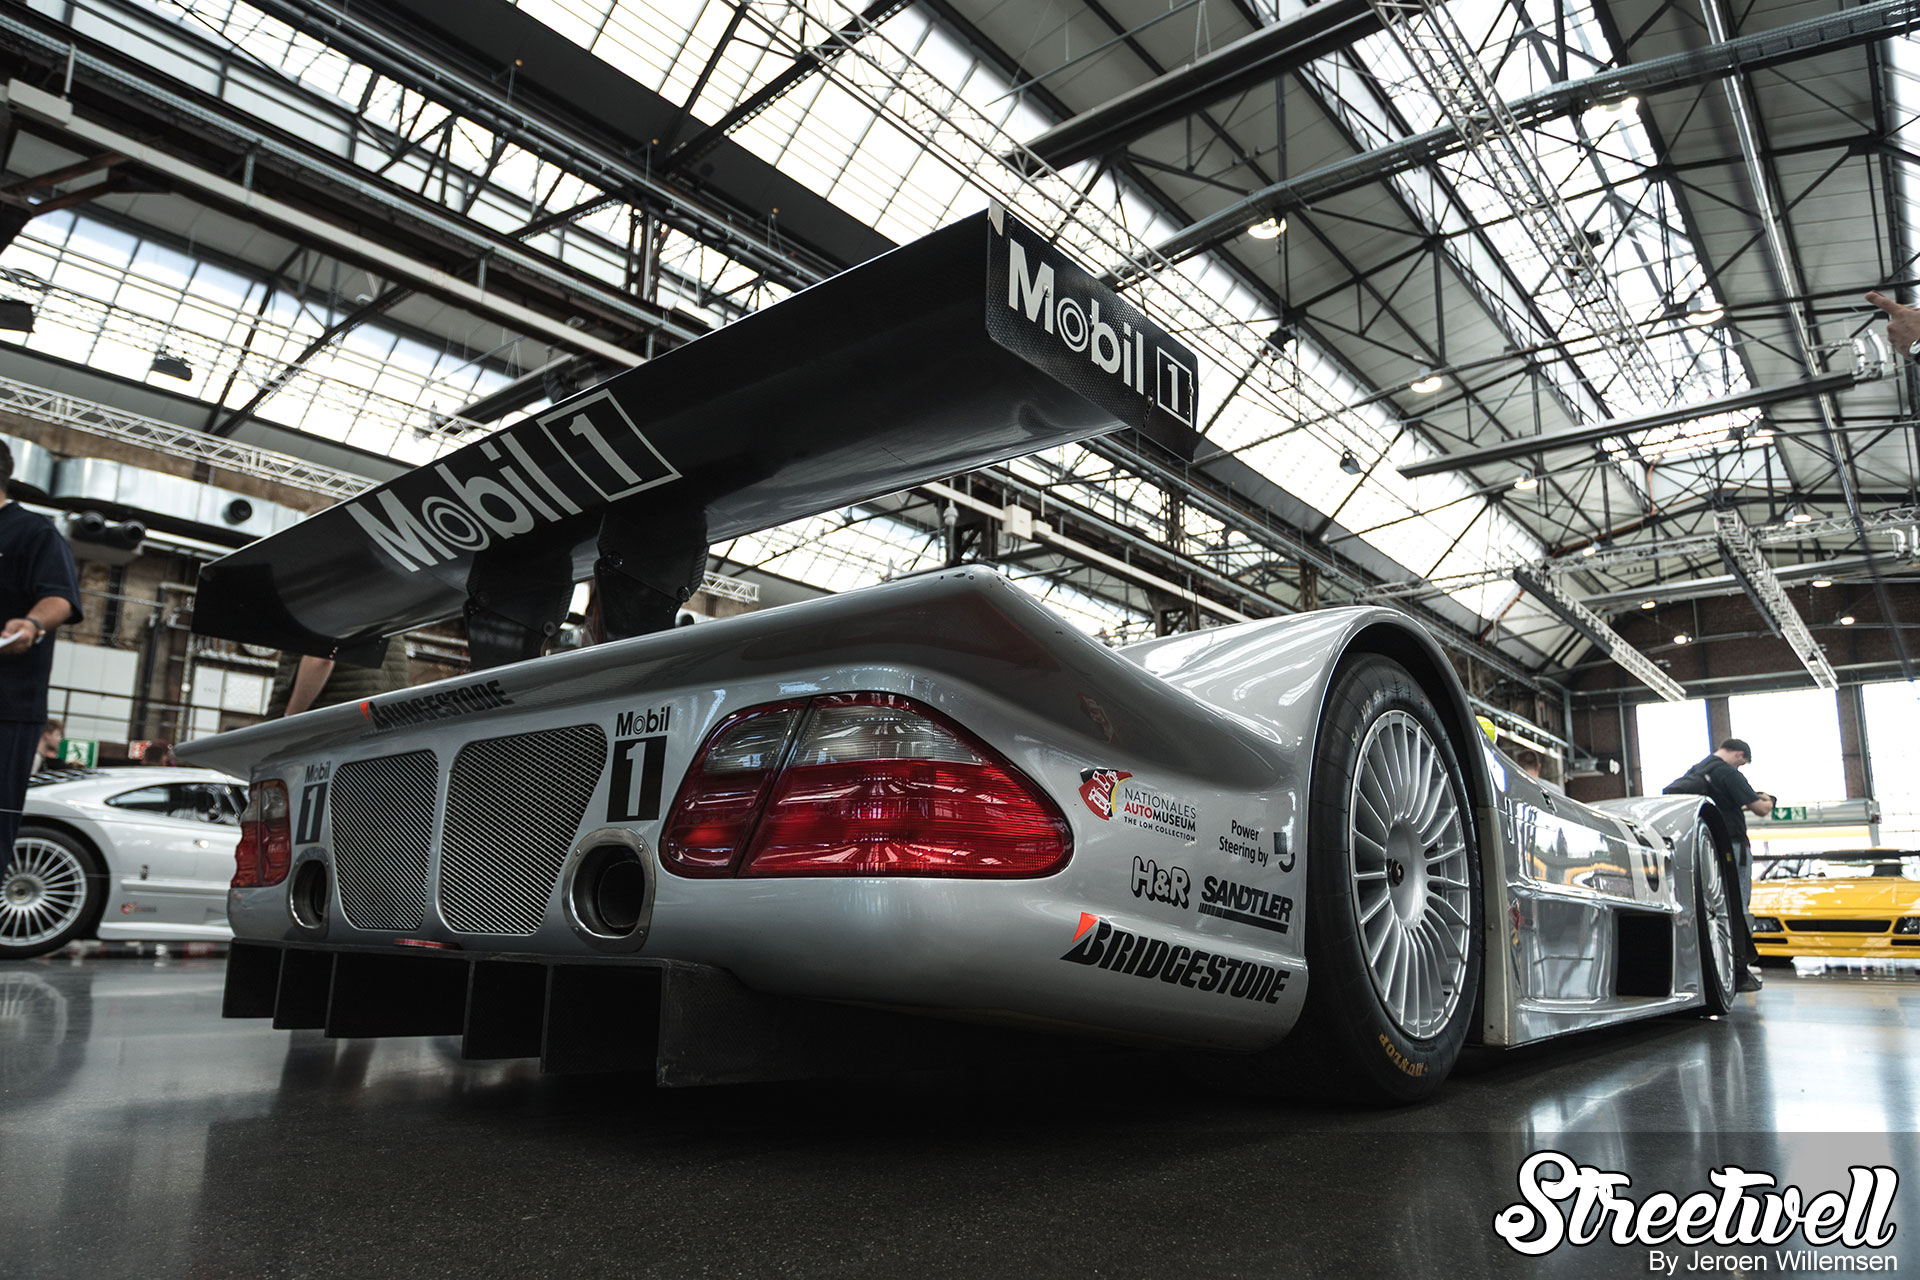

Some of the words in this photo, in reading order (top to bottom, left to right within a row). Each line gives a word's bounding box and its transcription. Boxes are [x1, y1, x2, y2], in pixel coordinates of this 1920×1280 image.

[1008, 238, 1144, 395] Mobil
[345, 432, 583, 572] Mobil
[568, 413, 642, 486] 1
[360, 679, 514, 730] BRIDGESTONE
[615, 706, 671, 737] Mobil
[304, 761, 331, 783] Mobil
[626, 741, 646, 816] 1
[1124, 787, 1197, 819] NATIONALES
[1124, 802, 1196, 832] AUTOMUSEUM
[1124, 816, 1137, 826] THE
[1140, 819, 1153, 830] LOH
[1155, 825, 1196, 842] COLLECTION
[1231, 819, 1259, 841] Power
[1219, 836, 1256, 863] Steering
[1257, 847, 1268, 867] by
[1131, 856, 1191, 909] H&R
[1201, 875, 1294, 922] SANDTLER
[1060, 912, 1291, 1004] BRIDGESTONE
[1378, 1033, 1424, 1077] DUNLOP
